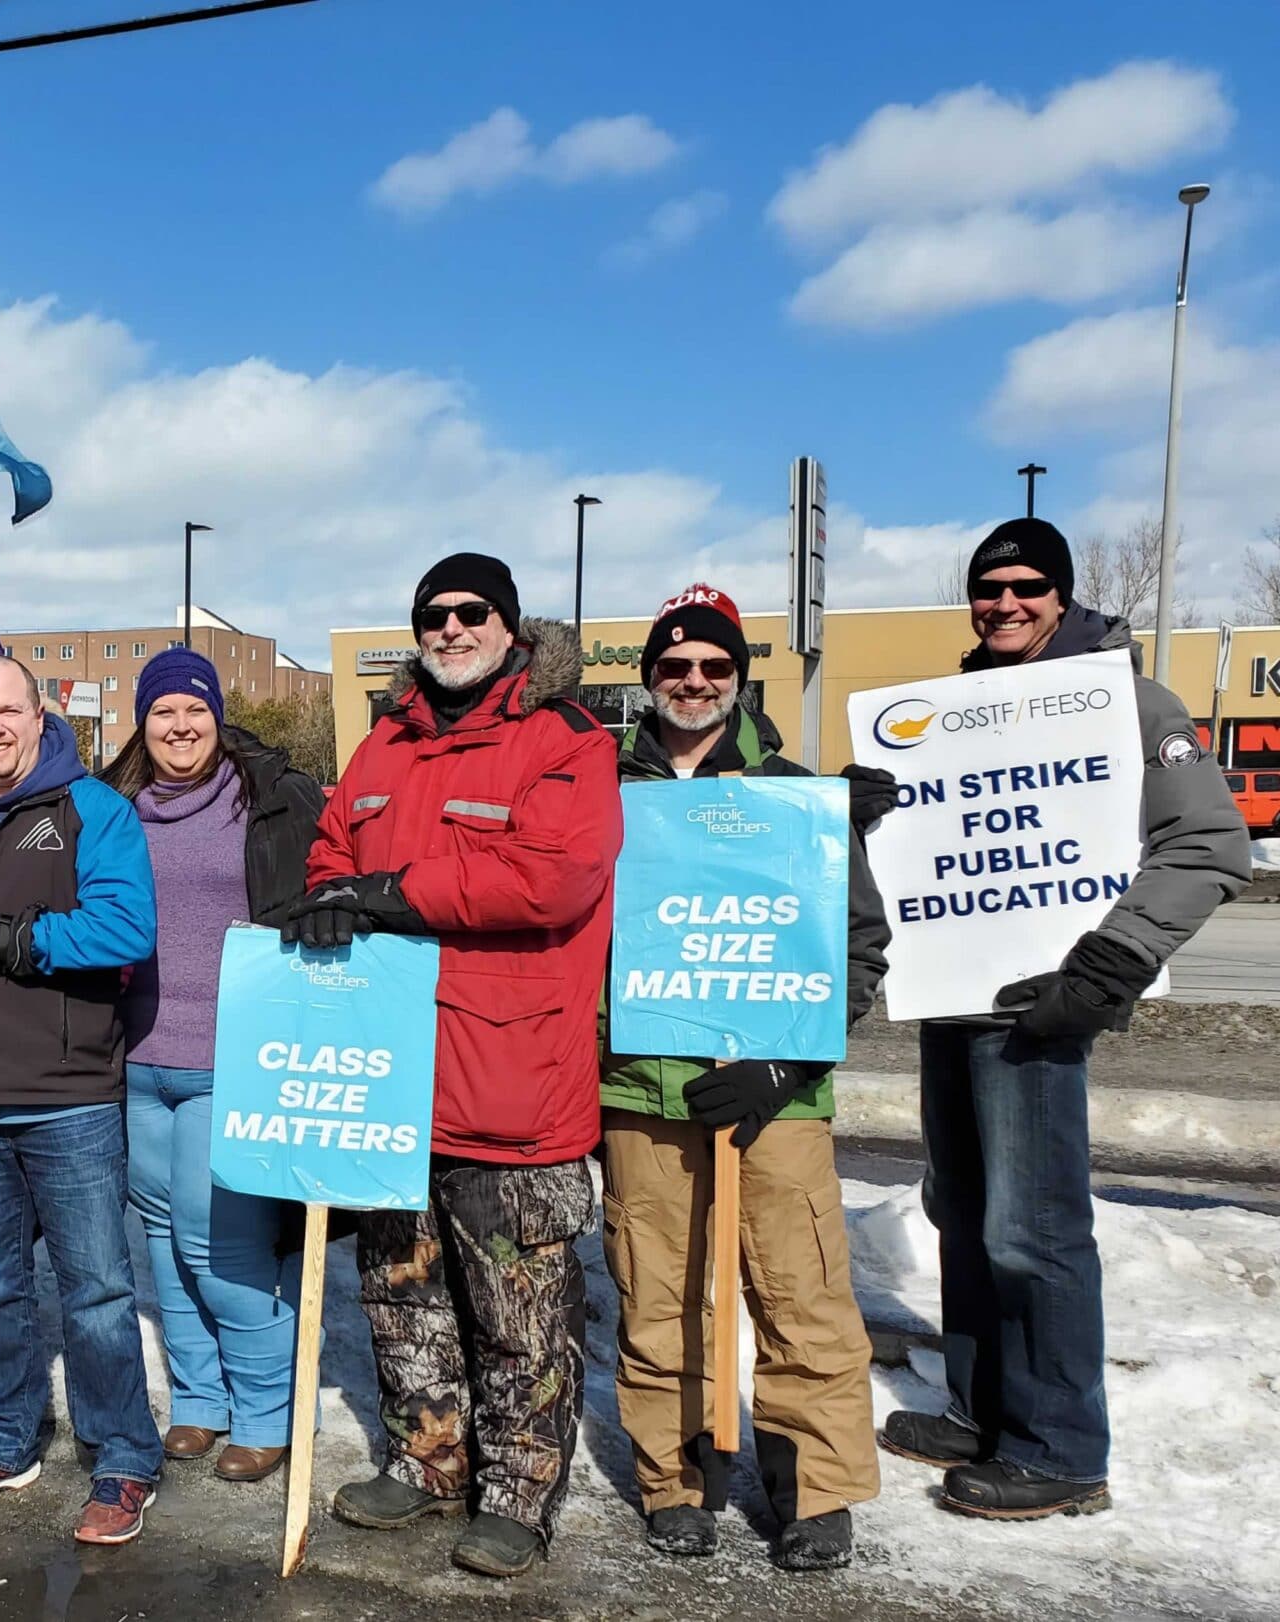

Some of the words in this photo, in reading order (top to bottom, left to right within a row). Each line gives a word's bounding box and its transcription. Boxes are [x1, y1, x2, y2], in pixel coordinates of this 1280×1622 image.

[361, 649, 423, 659] CHRYS
[582, 640, 645, 669] Jeep
[941, 688, 1111, 733] OSSTF/FEESO
[896, 778, 946, 809] ON
[959, 755, 1111, 799] STRIKE
[686, 807, 747, 823] Catholic
[704, 820, 772, 834] Teachers
[962, 804, 1043, 838] FOR
[934, 839, 1082, 880] PUBLIC
[657, 895, 801, 926] CLASS
[898, 873, 1130, 923] EDUCATION
[680, 932, 777, 963] SIZE
[289, 956, 348, 974] Catholic
[307, 972, 369, 988] Teachers
[622, 970, 833, 1003] MATTERS
[257, 1041, 393, 1078] CLASS
[278, 1080, 369, 1114] SIZE
[224, 1111, 418, 1153] MATTERS
